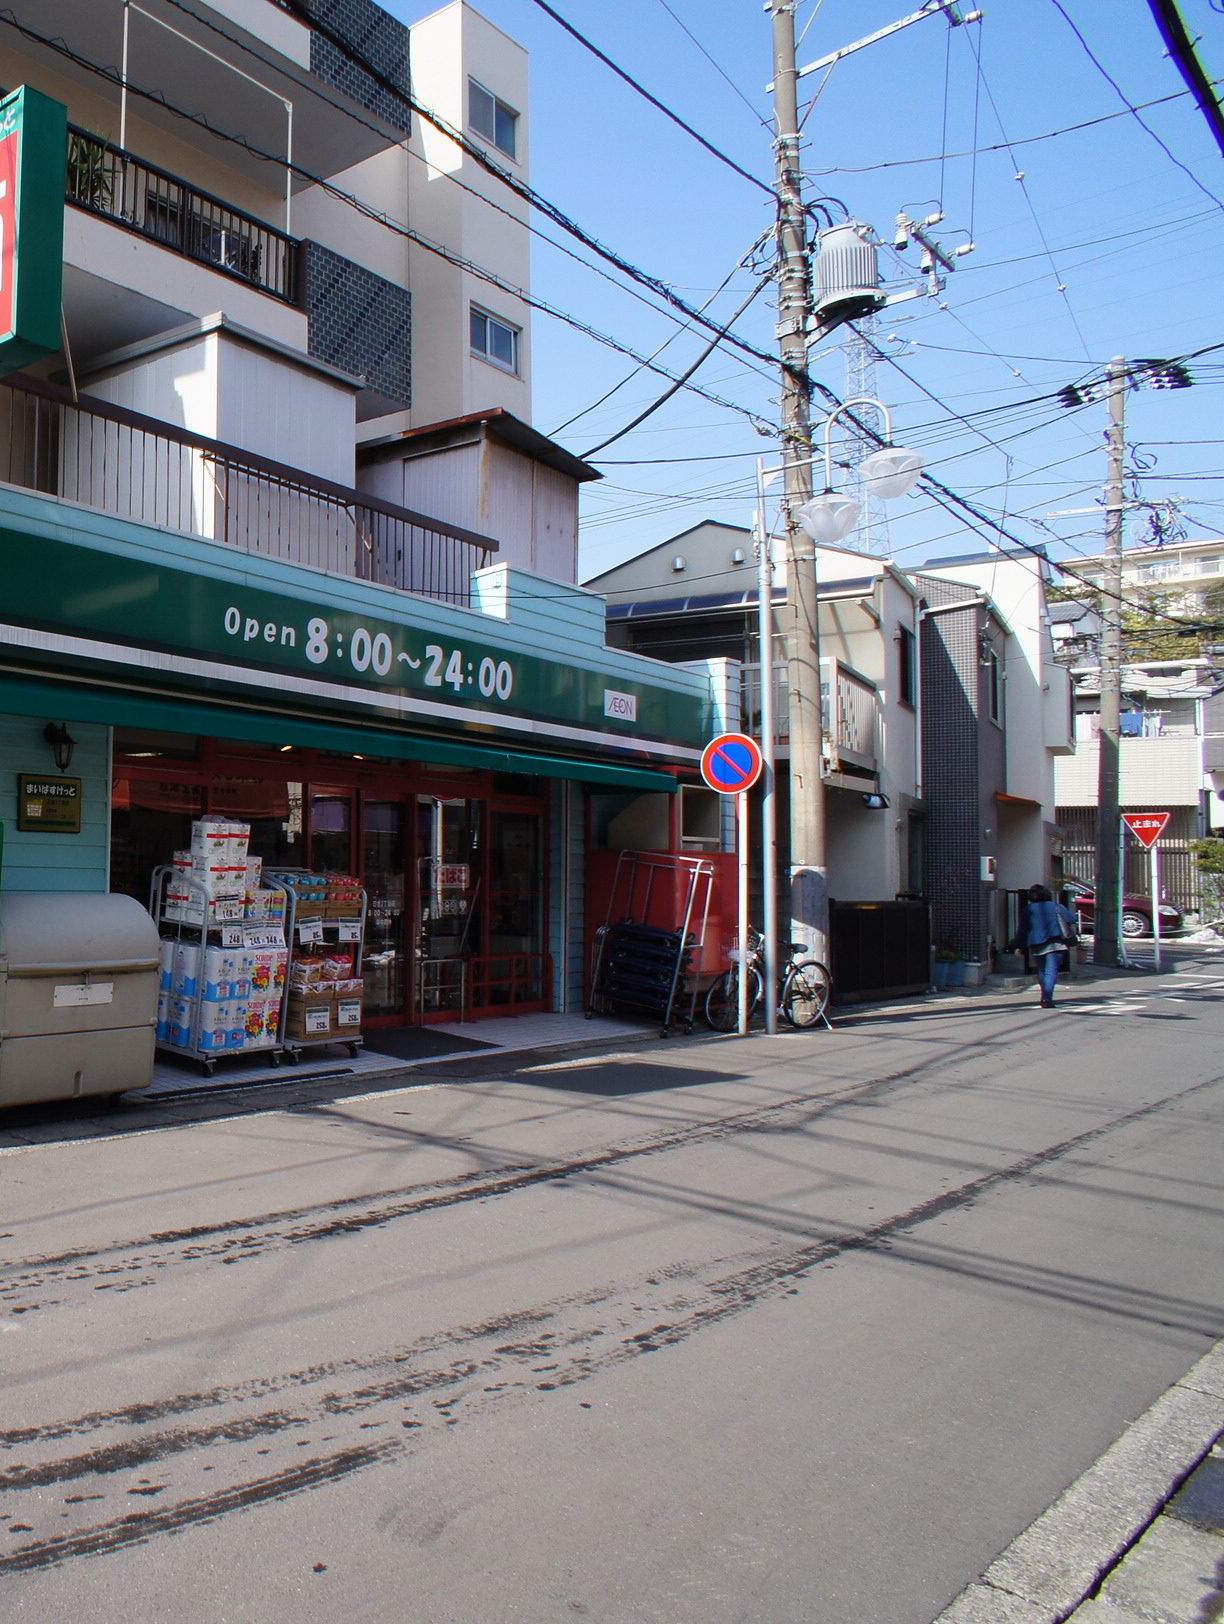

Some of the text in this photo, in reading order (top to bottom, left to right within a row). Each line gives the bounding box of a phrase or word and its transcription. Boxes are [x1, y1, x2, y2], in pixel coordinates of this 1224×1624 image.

[224, 606, 296, 648] Open
[25, 783, 76, 797] まいばすけっと
[1131, 819, 1162, 829] 止まれ
